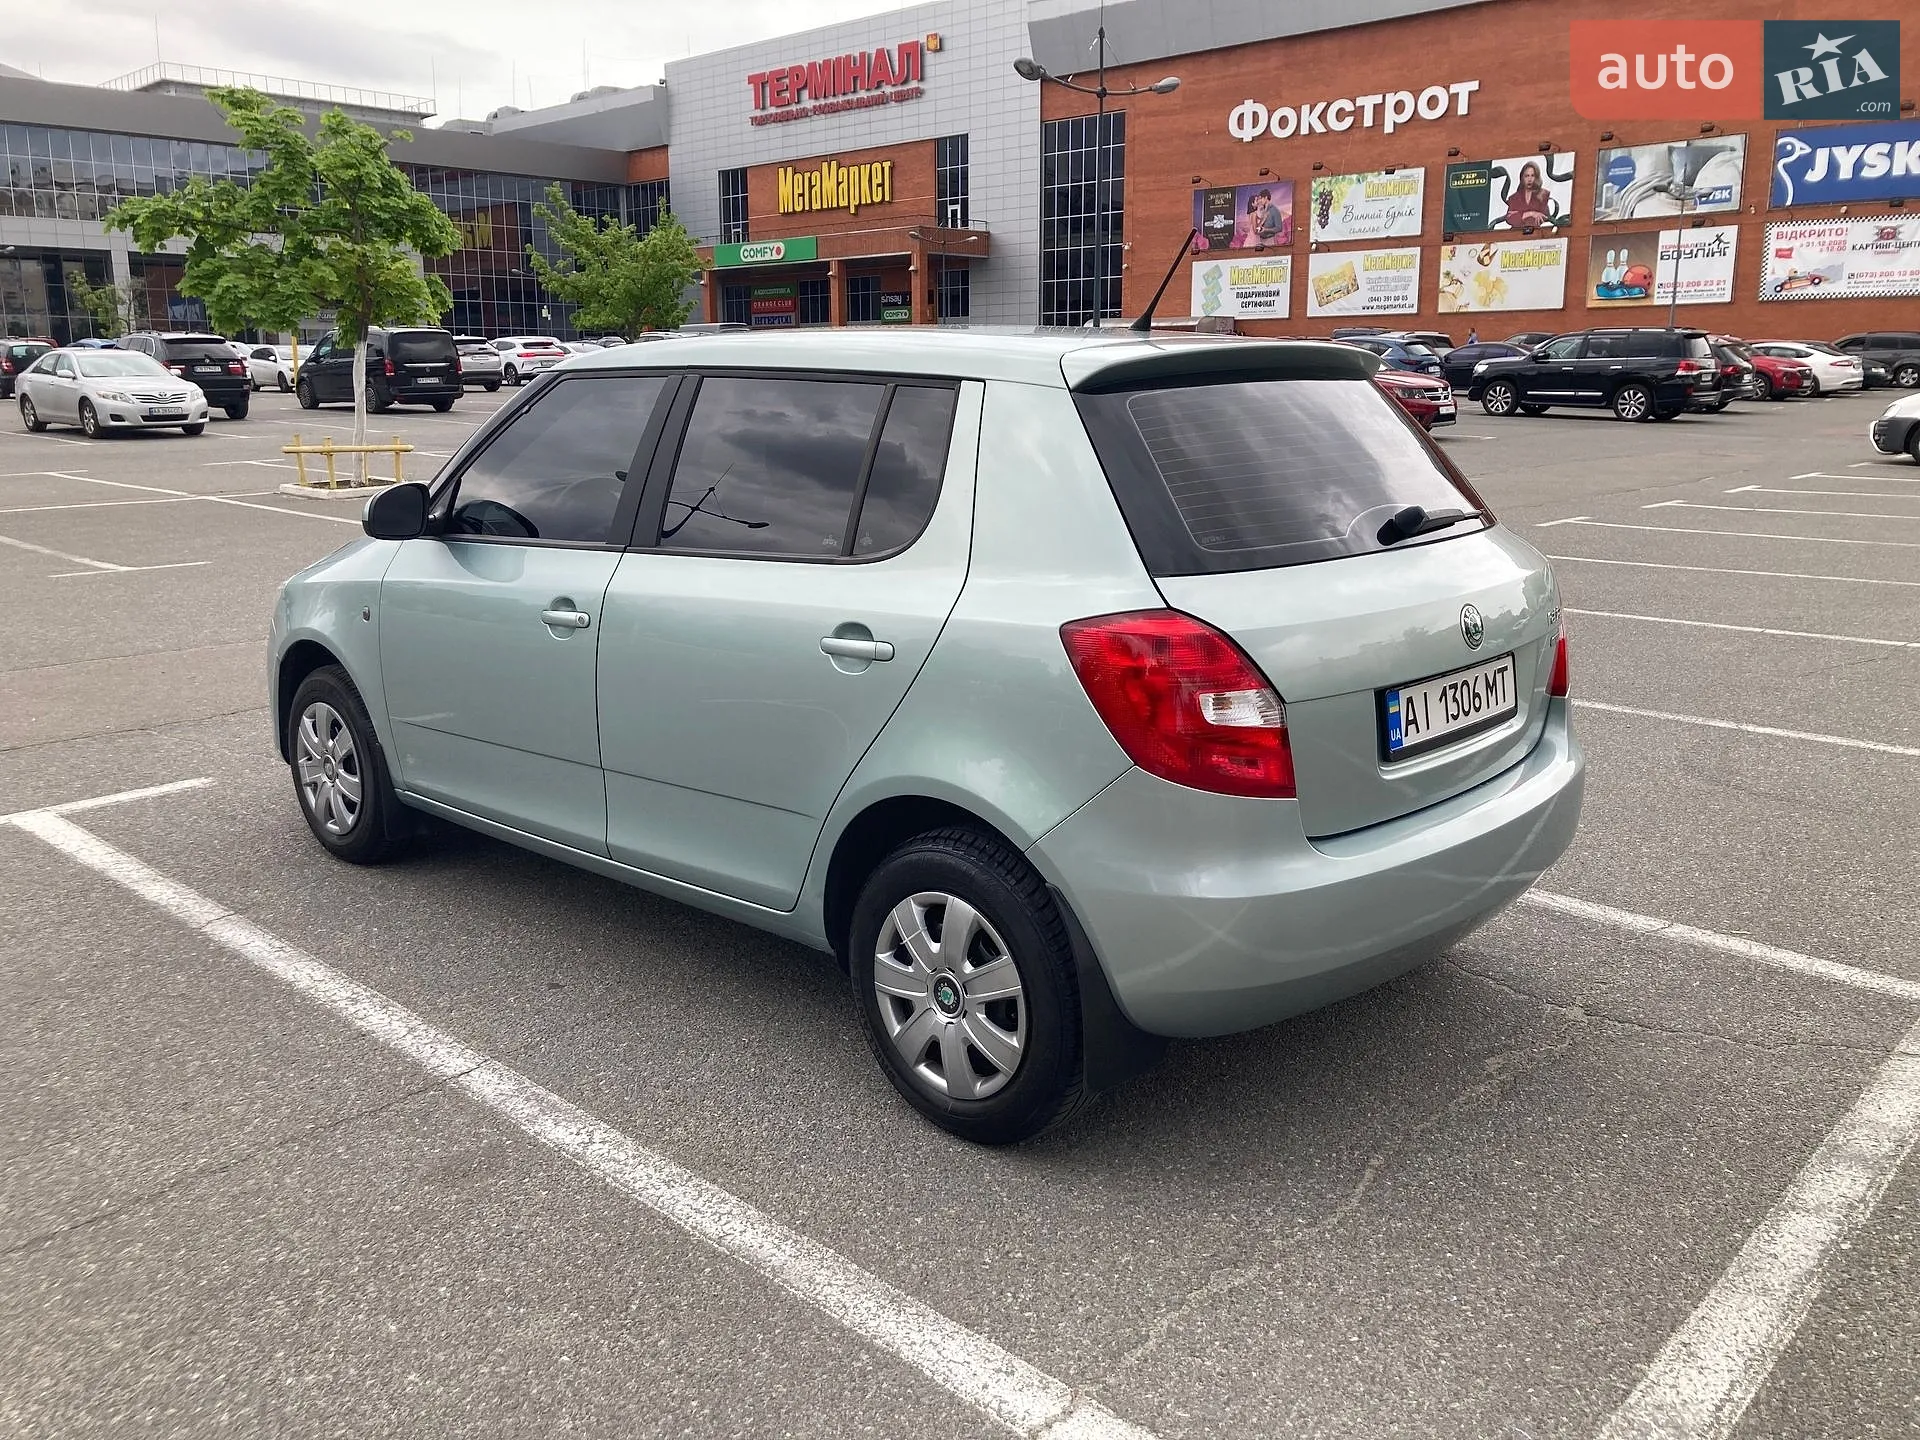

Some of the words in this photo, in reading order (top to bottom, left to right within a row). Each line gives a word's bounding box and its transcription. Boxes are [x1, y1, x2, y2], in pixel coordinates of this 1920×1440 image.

[747, 40, 922, 111] ТЕРМІНАЛ
[1228, 80, 1480, 142] Фокстрот
[1804, 139, 1920, 182] JYSK
[778, 160, 894, 216] МегаМаркет
[742, 244, 774, 259] COMFY
[1660, 246, 1729, 260] БОУЛІНГ
[1775, 227, 1849, 241] ВІДКРИТО!
[1438, 674, 1482, 724] 1306
[1484, 665, 1509, 709] MT
[1390, 727, 1402, 741] UA
